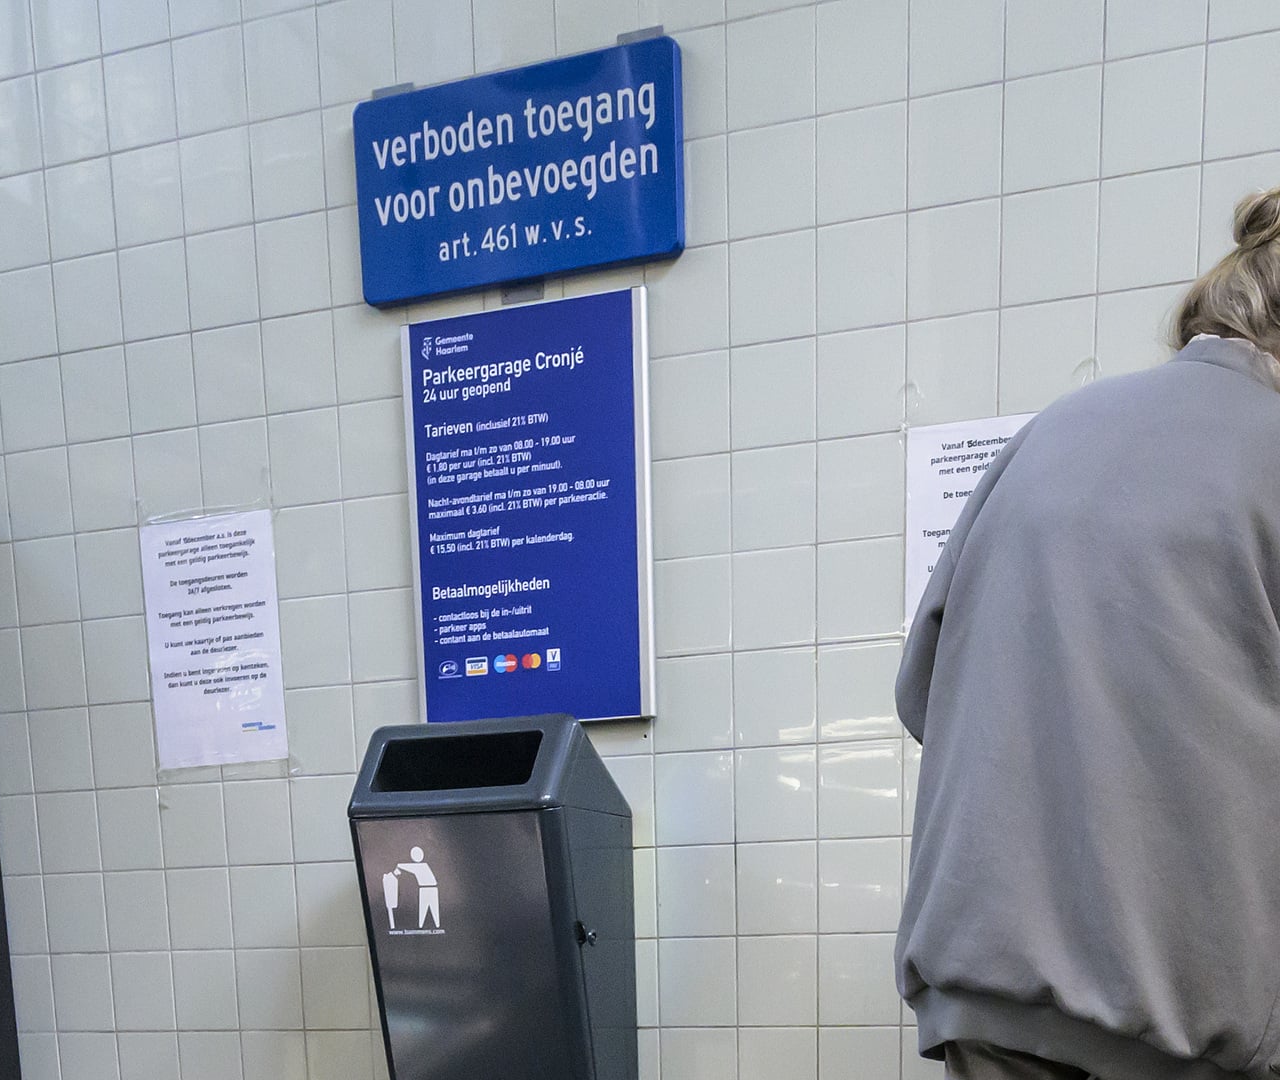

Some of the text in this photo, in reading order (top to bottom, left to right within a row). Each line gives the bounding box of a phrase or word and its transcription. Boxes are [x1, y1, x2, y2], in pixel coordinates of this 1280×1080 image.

[372, 82, 656, 170] verboden toegang
[375, 141, 659, 226] voor onbevoegden
[439, 232, 477, 261] art.
[481, 223, 517, 252] 461
[435, 333, 473, 345] Gemeente
[436, 344, 468, 356] Haarlem
[423, 346, 584, 387] Parkeergarage Cronjé
[423, 378, 511, 403] 24 uur geopend
[424, 412, 549, 438] Tarieven (inclusief 21% BTW)
[426, 450, 459, 462] Dagtarief
[461, 448, 472, 457] ma
[474, 446, 487, 455] t/m
[541, 436, 560, 446] 19.00
[562, 434, 576, 444] uur
[942, 441, 964, 450] Vanaf
[449, 461, 461, 472] per
[463, 460, 476, 468] uur
[497, 454, 510, 464] 21%
[512, 452, 532, 462] BTW)
[931, 451, 988, 465] parkeergarage
[427, 476, 436, 485] (in
[438, 473, 455, 483] deze
[457, 471, 482, 483] garage
[484, 466, 509, 477] betaalt
[517, 465, 529, 477] per
[428, 492, 493, 508] Nacht-avondtarief
[494, 491, 506, 499] ma
[508, 488, 521, 498] t/m
[533, 486, 546, 495] van
[548, 482, 568, 493] 19.00
[596, 479, 610, 487] uur
[428, 508, 464, 520] maximaal
[507, 500, 521, 510] 21%
[523, 497, 542, 508] BTW)
[544, 496, 556, 507] per
[430, 526, 500, 542] Maximum dagtarief
[436, 544, 455, 553] 15.50
[476, 539, 489, 549] 21%
[491, 537, 510, 548] BTW)
[512, 535, 524, 547] per
[433, 577, 550, 600] Betaalmogelijkheden
[439, 610, 479, 622] contactloos
[480, 609, 489, 620] bij
[491, 608, 500, 618] de
[439, 622, 486, 635] parkeer apps
[440, 634, 466, 644] contant
[468, 634, 481, 643] aan
[493, 627, 549, 640] betaalautomaat
